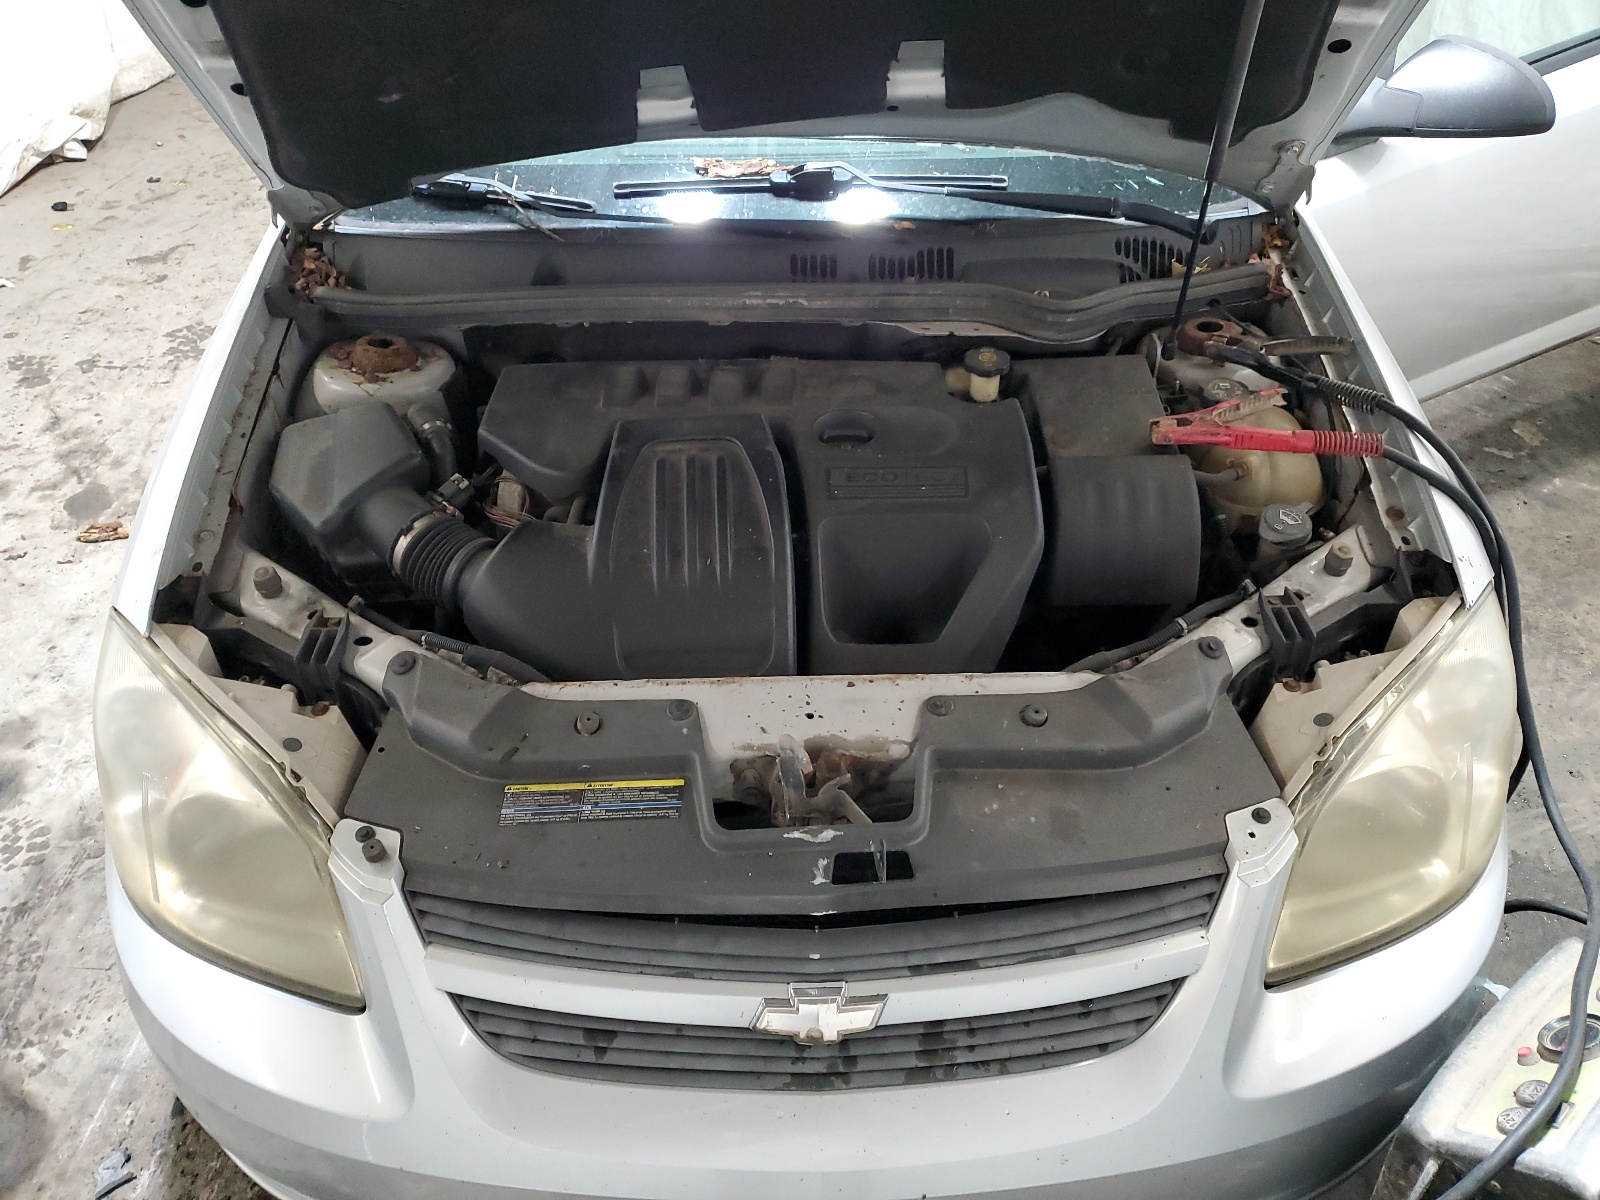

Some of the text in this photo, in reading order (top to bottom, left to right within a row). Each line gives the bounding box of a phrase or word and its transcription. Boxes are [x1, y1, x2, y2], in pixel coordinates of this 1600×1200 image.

[847, 471, 948, 483] ECOTEC
[1528, 1083, 1547, 1100] 12V
[1500, 1112, 1518, 1128] 12V
